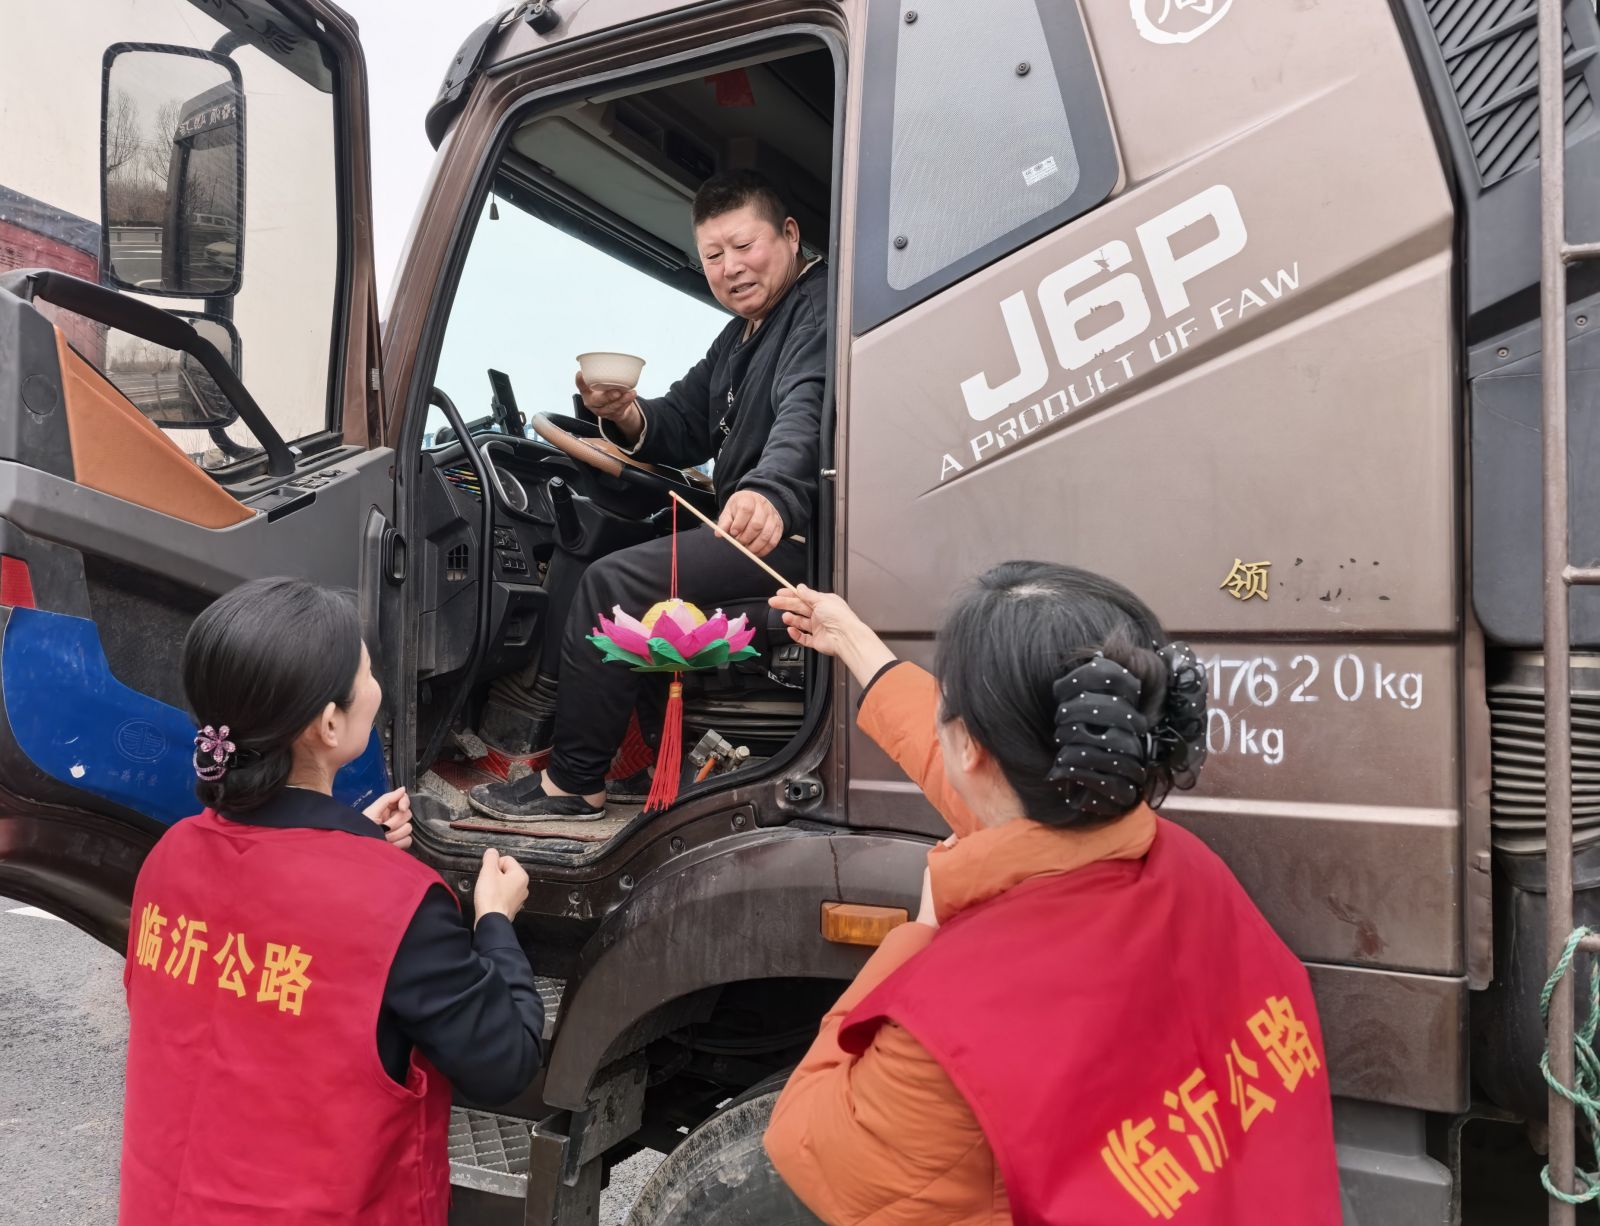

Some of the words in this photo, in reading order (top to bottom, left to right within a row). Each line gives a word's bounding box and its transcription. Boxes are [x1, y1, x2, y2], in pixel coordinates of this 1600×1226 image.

[940, 453, 964, 481] A
[970, 351, 1135, 461] PRODUCT
[1149, 317, 1199, 362] OF
[1210, 261, 1300, 330] FAW
[961, 184, 1248, 421] J6P
[1219, 558, 1272, 601] 领
[136, 902, 313, 1016] 临沂公路
[1101, 995, 1321, 1220] 临沂公路
